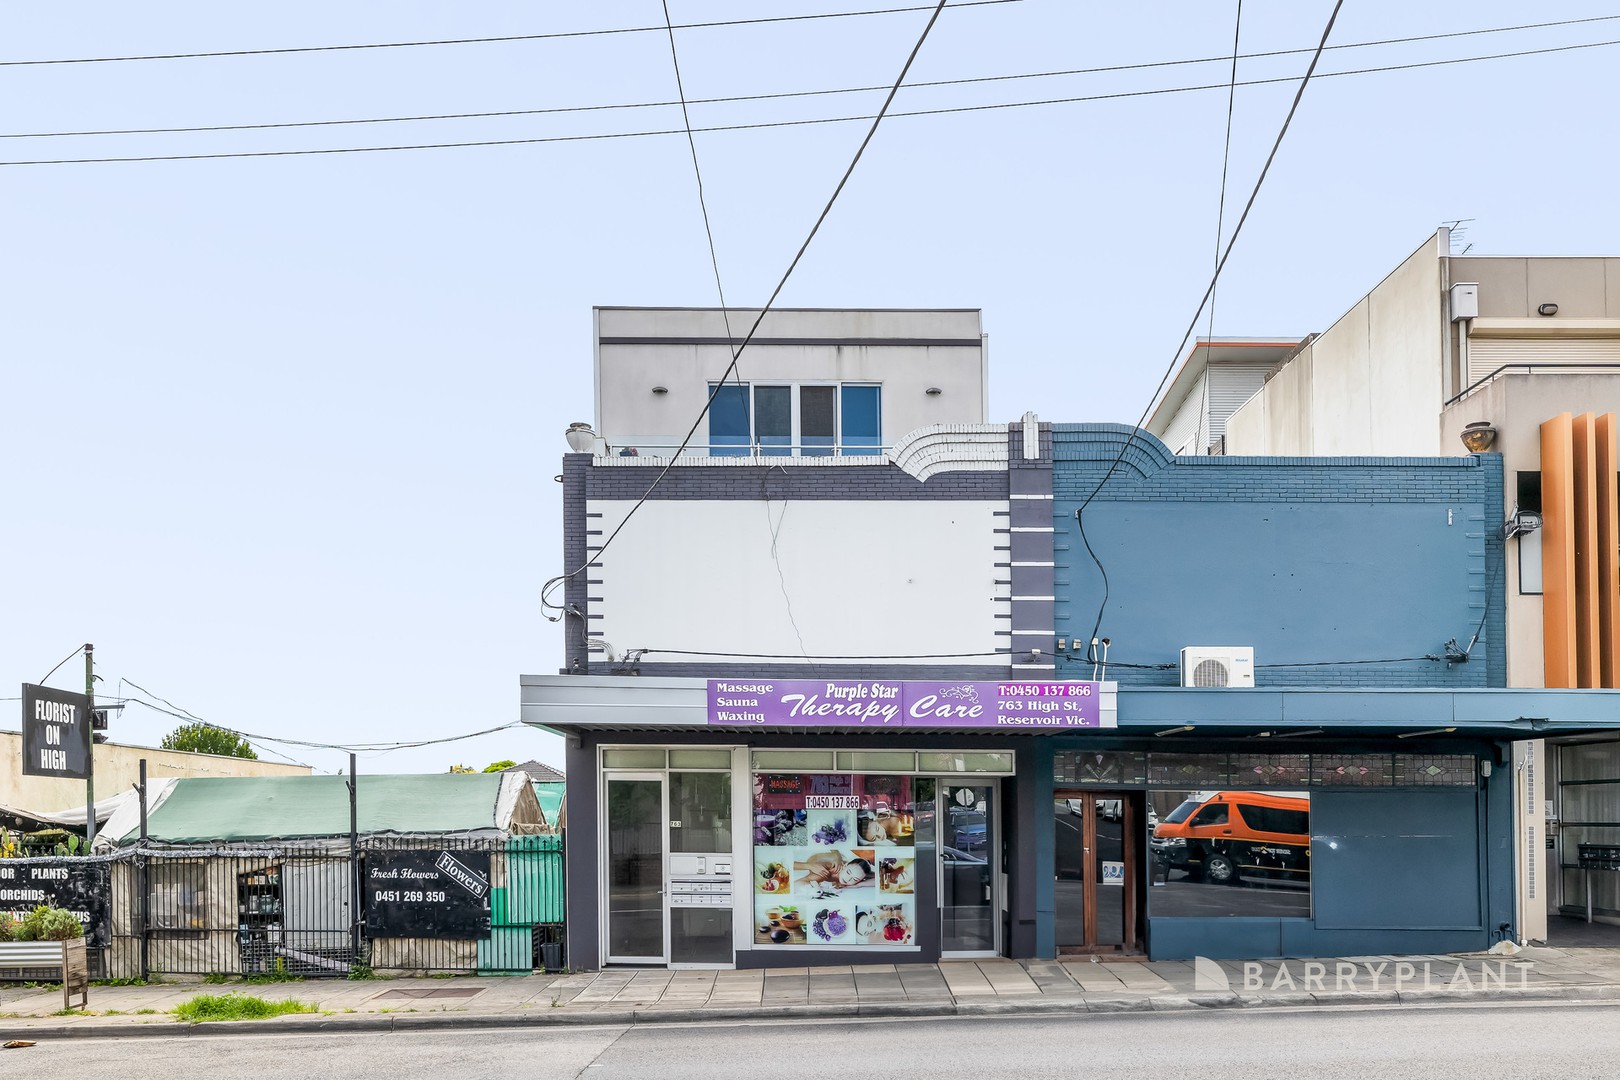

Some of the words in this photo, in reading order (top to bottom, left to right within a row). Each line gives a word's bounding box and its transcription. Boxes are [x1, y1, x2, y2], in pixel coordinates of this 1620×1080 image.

[717, 683, 774, 695] Massage
[825, 683, 868, 701] Purple
[870, 683, 899, 699] Star
[998, 685, 1040, 696] T:0450
[1043, 685, 1065, 696] 137
[1068, 685, 1091, 696] 866
[717, 697, 758, 707] Sauna
[781, 693, 900, 723] Therapy
[909, 694, 984, 718] Care
[997, 700, 1023, 710] 763
[1028, 700, 1060, 712] High
[1063, 701, 1082, 712] St,
[35, 699, 76, 724] FLORIST
[717, 711, 765, 723] Waxing
[997, 715, 1062, 725] Reservoir
[1066, 714, 1090, 725] Vic.
[45, 724, 60, 745] ON
[40, 748, 67, 770] HIGH
[806, 797, 829, 808] T:0450
[831, 797, 843, 808] 137
[845, 797, 859, 808] 866
[31, 868, 69, 880] PLANTS
[370, 867, 399, 879] Fresh
[400, 868, 439, 879] Flowers
[439, 854, 483, 894] Flowers
[0, 889, 45, 901] ORCHIDS
[375, 891, 400, 902] 0451
[403, 891, 423, 902] 269
[426, 891, 446, 902] 350
